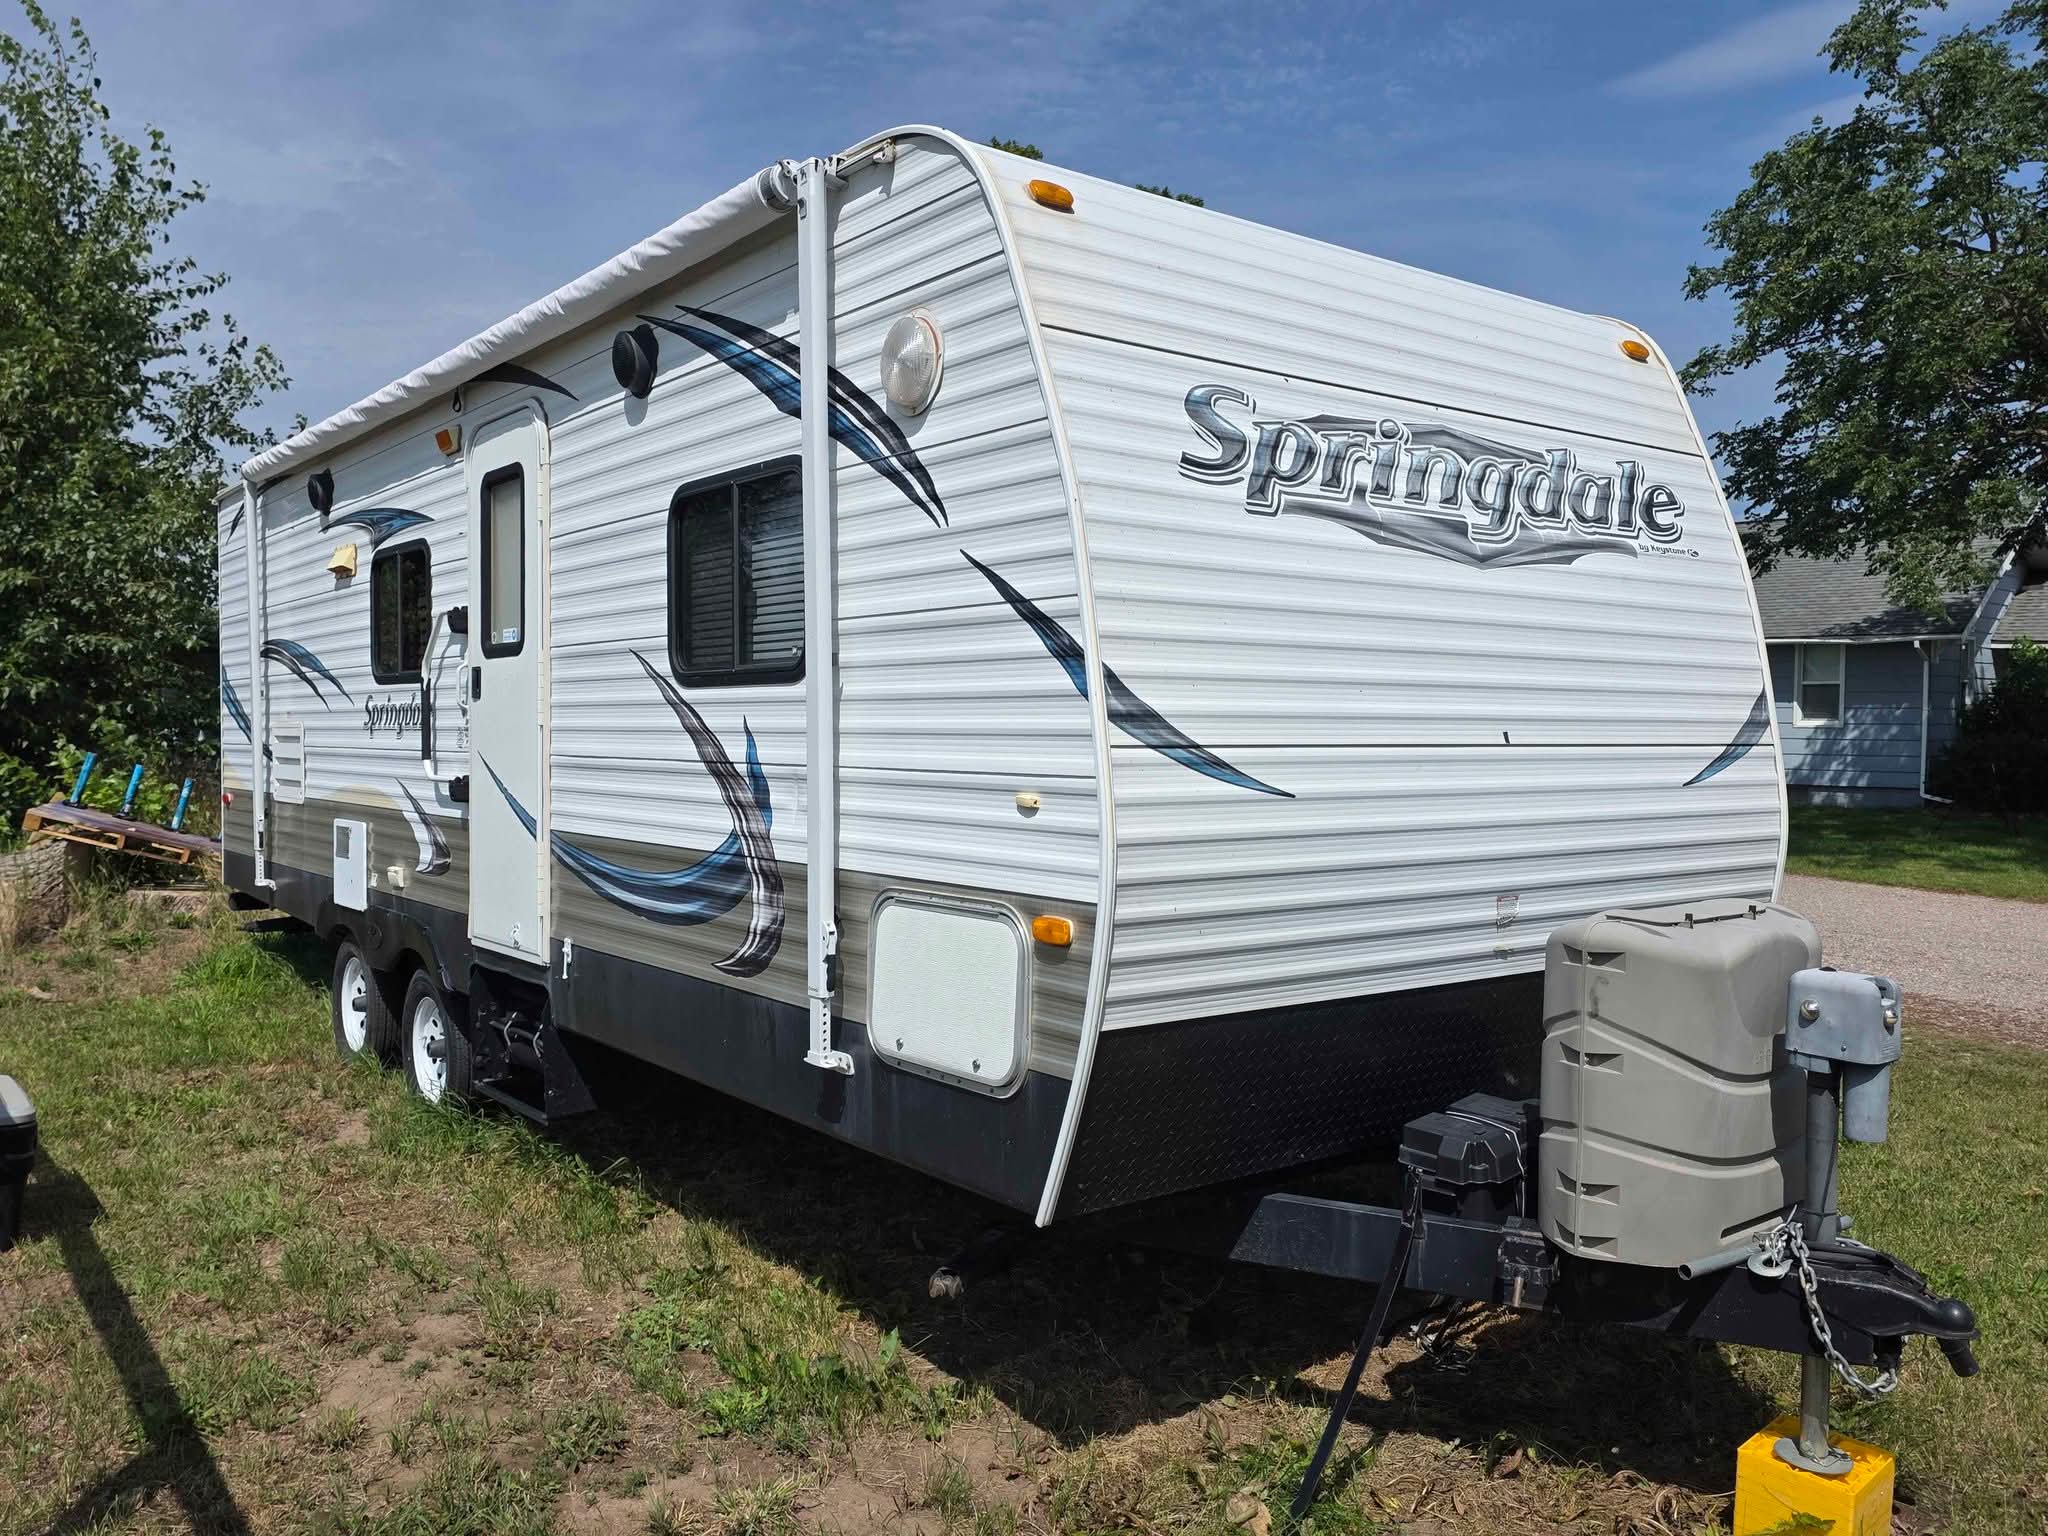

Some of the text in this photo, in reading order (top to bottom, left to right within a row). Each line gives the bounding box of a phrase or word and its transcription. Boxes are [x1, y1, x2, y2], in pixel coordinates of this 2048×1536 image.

[1178, 384, 1684, 543] Springdale
[1638, 543, 1649, 552] by
[1650, 544, 1686, 555] Keystone
[363, 692, 422, 739] Springda
